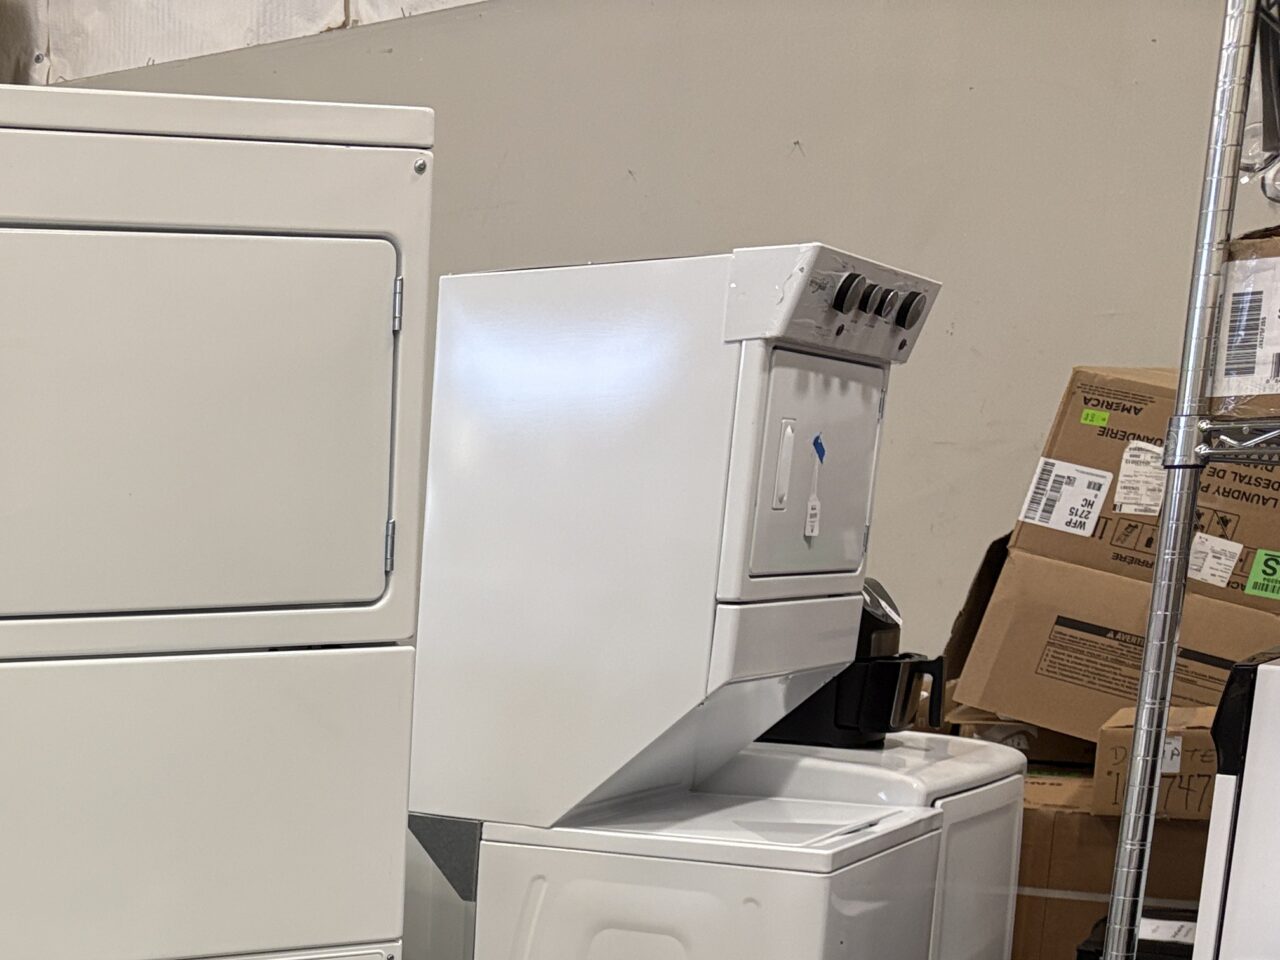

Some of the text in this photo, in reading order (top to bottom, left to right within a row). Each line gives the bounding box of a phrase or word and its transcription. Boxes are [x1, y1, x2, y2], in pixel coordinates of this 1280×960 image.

[1083, 396, 1143, 415] AMERICA
[1097, 426, 1164, 447] UANDERIE
[1207, 466, 1226, 479] DE
[1231, 471, 1280, 491] DESTAL
[1081, 498, 1095, 509] HC
[1213, 485, 1279, 508] LAUNDRY
[1069, 507, 1091, 520] 2715
[1065, 518, 1086, 531] WFP
[1112, 552, 1155, 569] RRIÈRE
